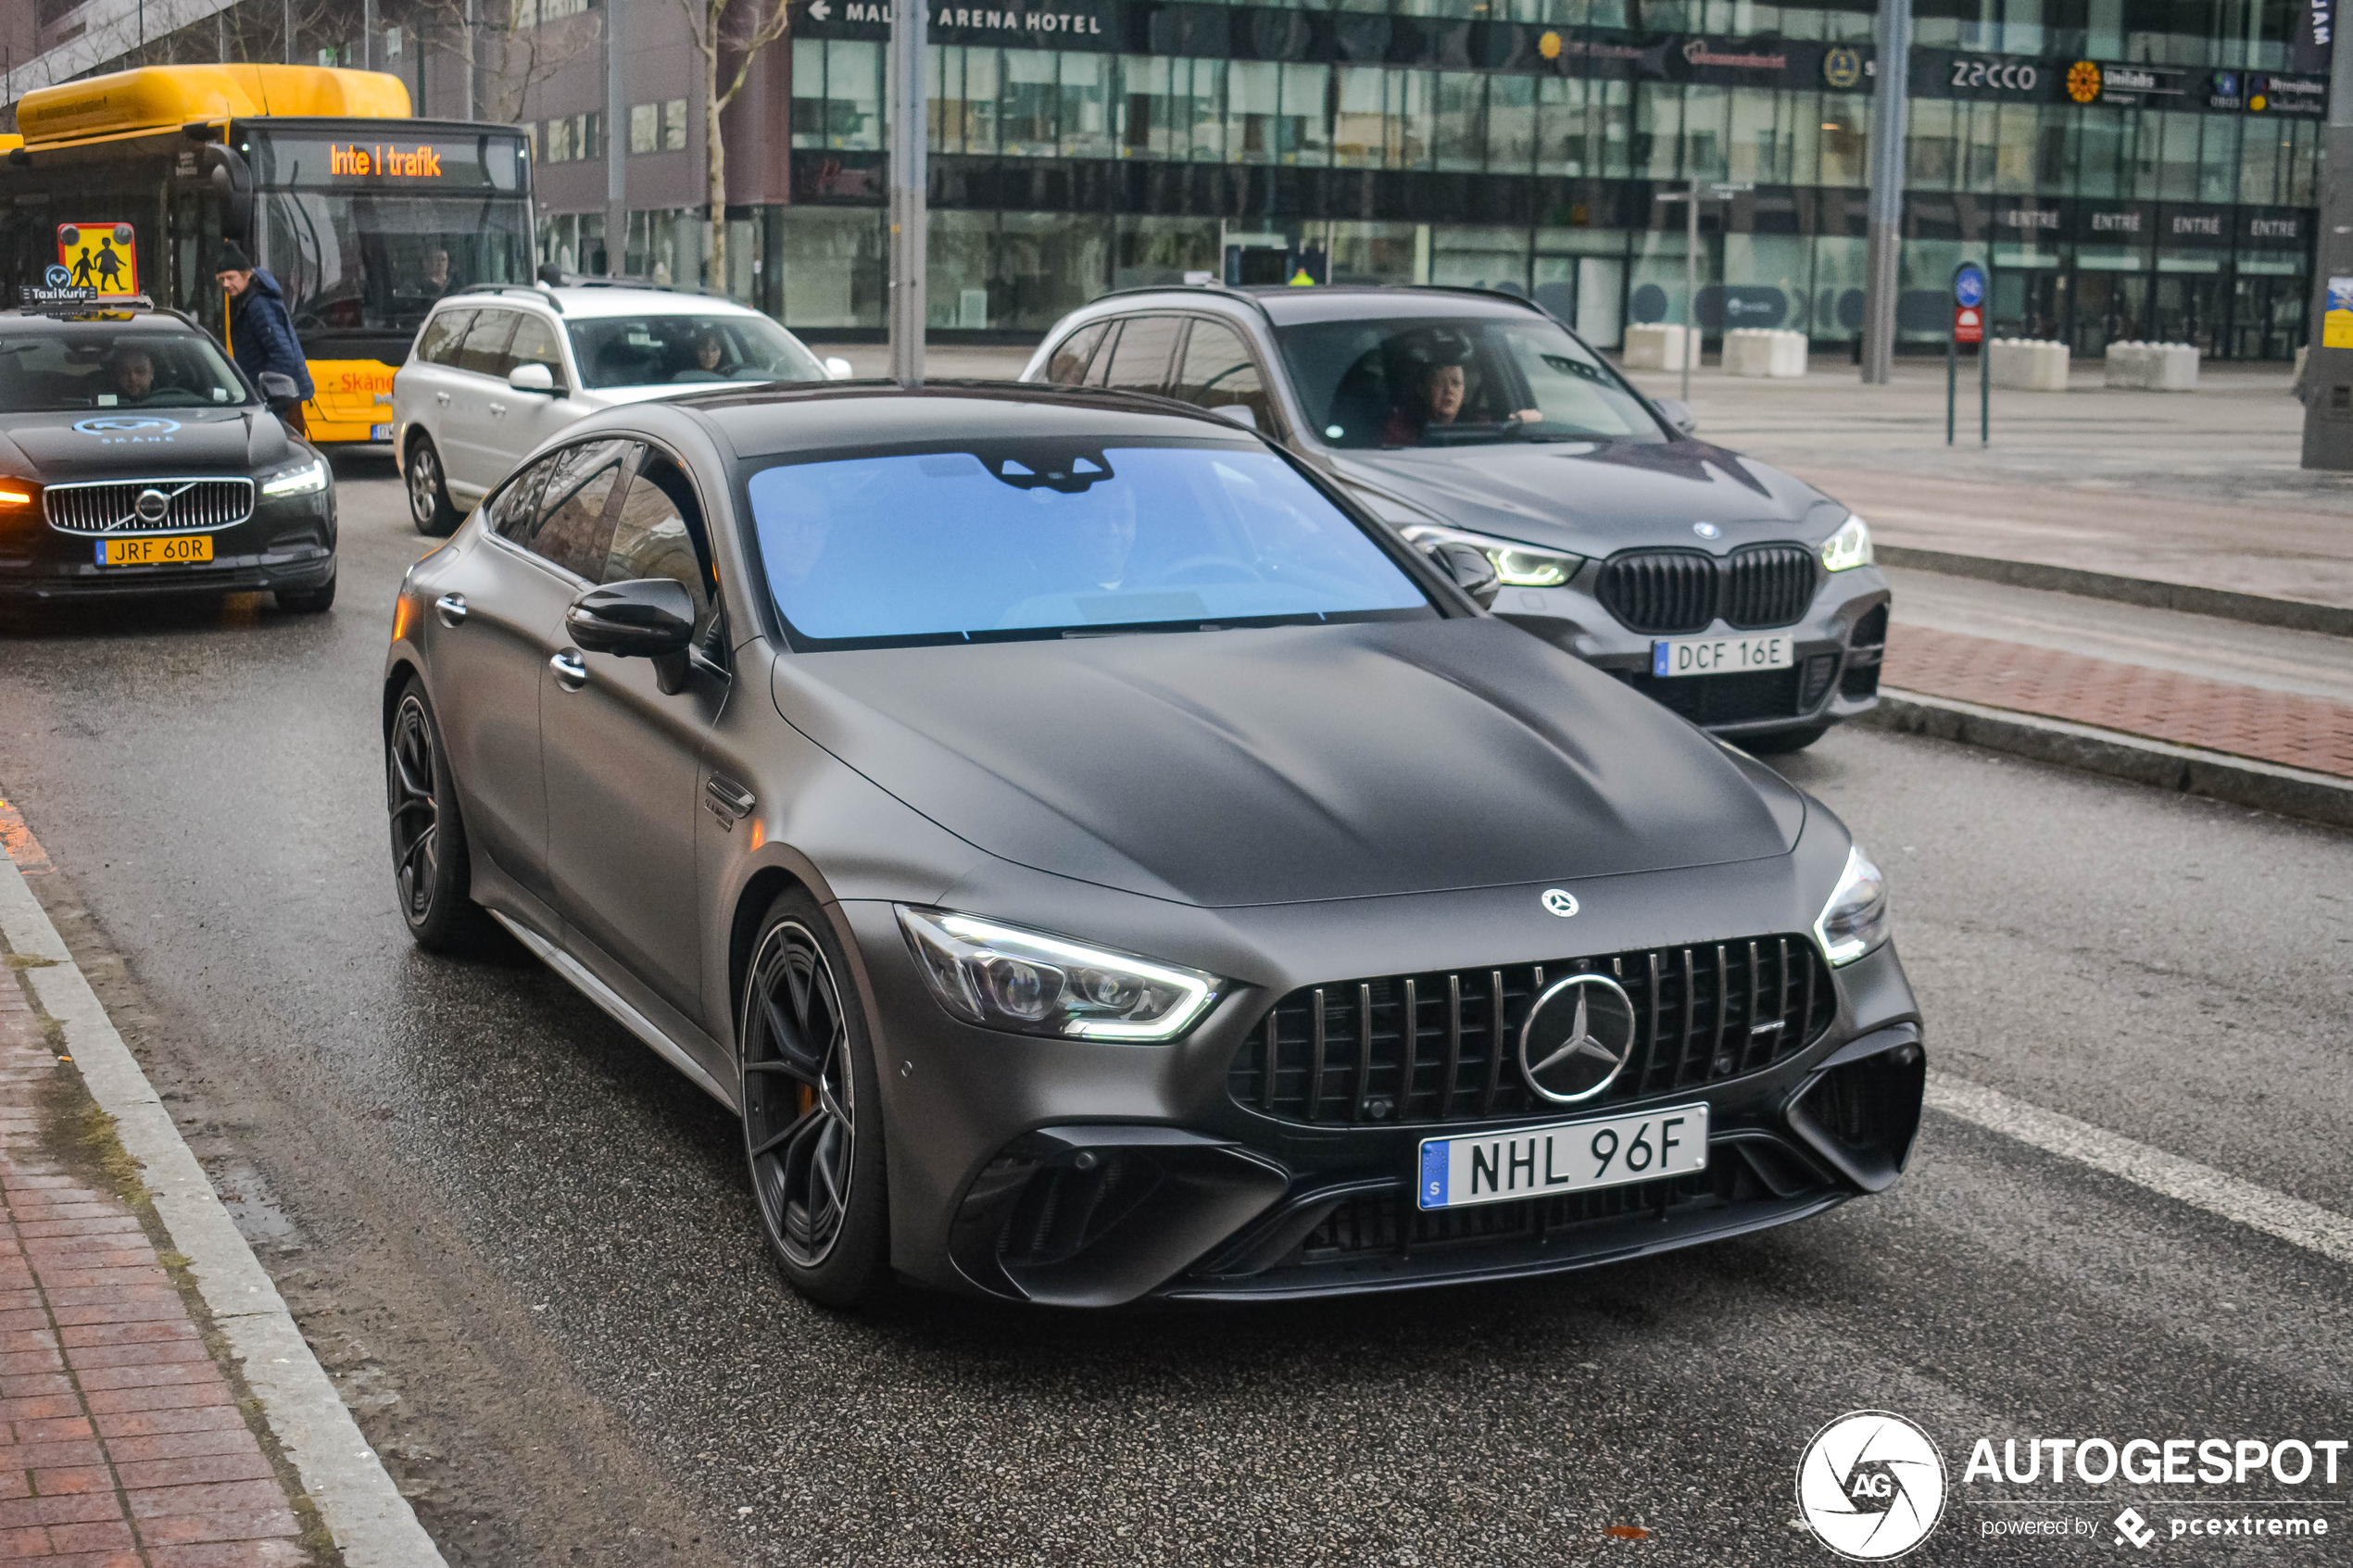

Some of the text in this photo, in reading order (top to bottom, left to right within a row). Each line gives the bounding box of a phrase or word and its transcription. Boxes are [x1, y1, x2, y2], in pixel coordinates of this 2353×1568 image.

[937, 8, 1017, 30] ARENA
[1026, 12, 1101, 34] HOTEL
[331, 144, 371, 175] Inte
[387, 145, 442, 177] trafik
[115, 539, 203, 561] JRF 60R
[1679, 639, 1780, 671] DCF 16E
[1470, 1116, 1685, 1195] NHL 96F
[1429, 1181, 1441, 1197] S
